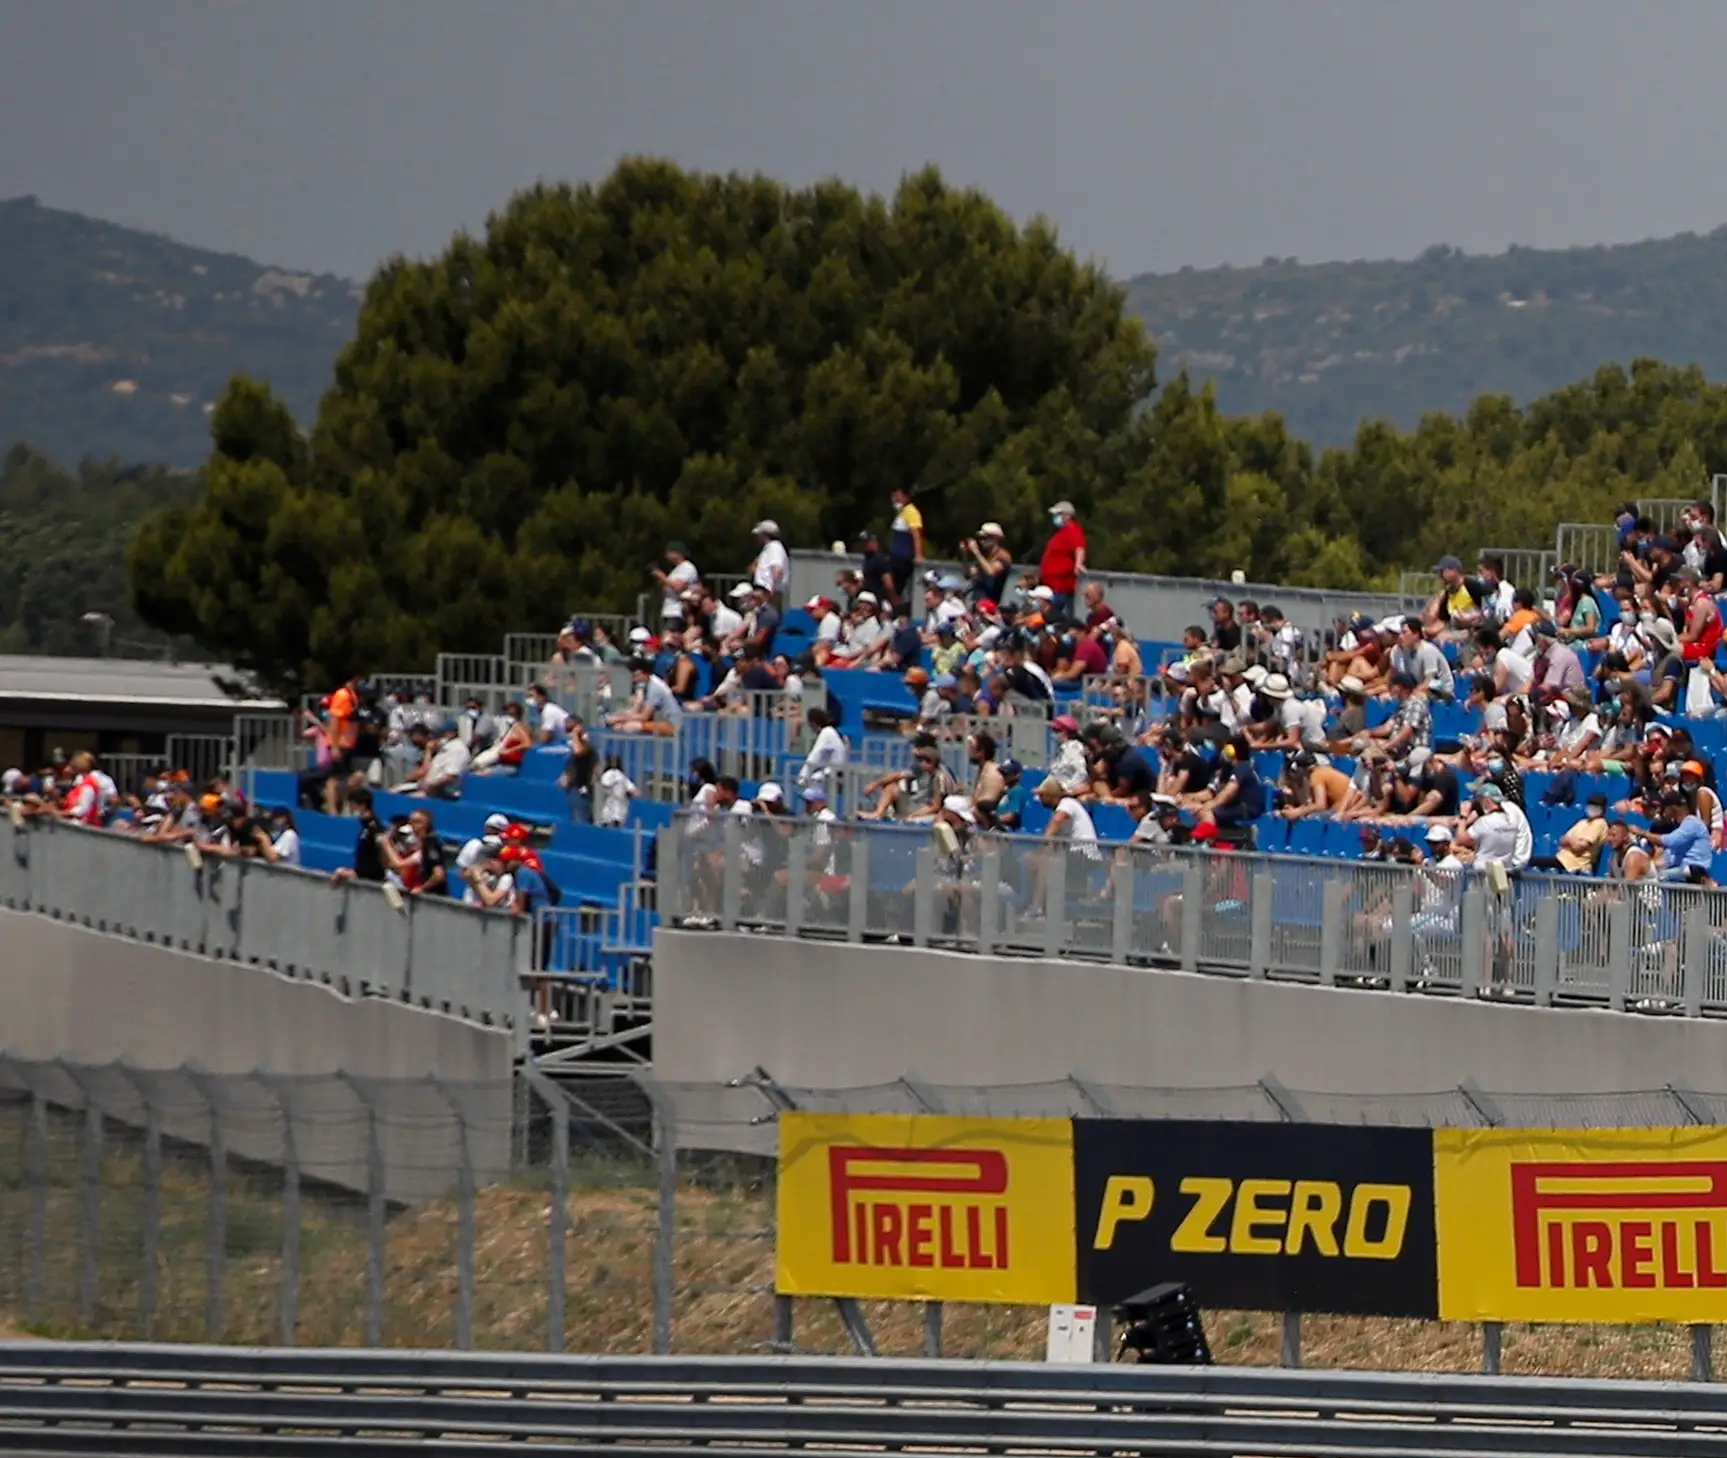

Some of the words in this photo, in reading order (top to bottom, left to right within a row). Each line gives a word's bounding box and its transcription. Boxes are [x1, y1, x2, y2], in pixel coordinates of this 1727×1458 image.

[829, 1146, 1008, 1269] PIRELLI
[1093, 1175, 1155, 1250] P
[1170, 1176, 1412, 1260] ZERO
